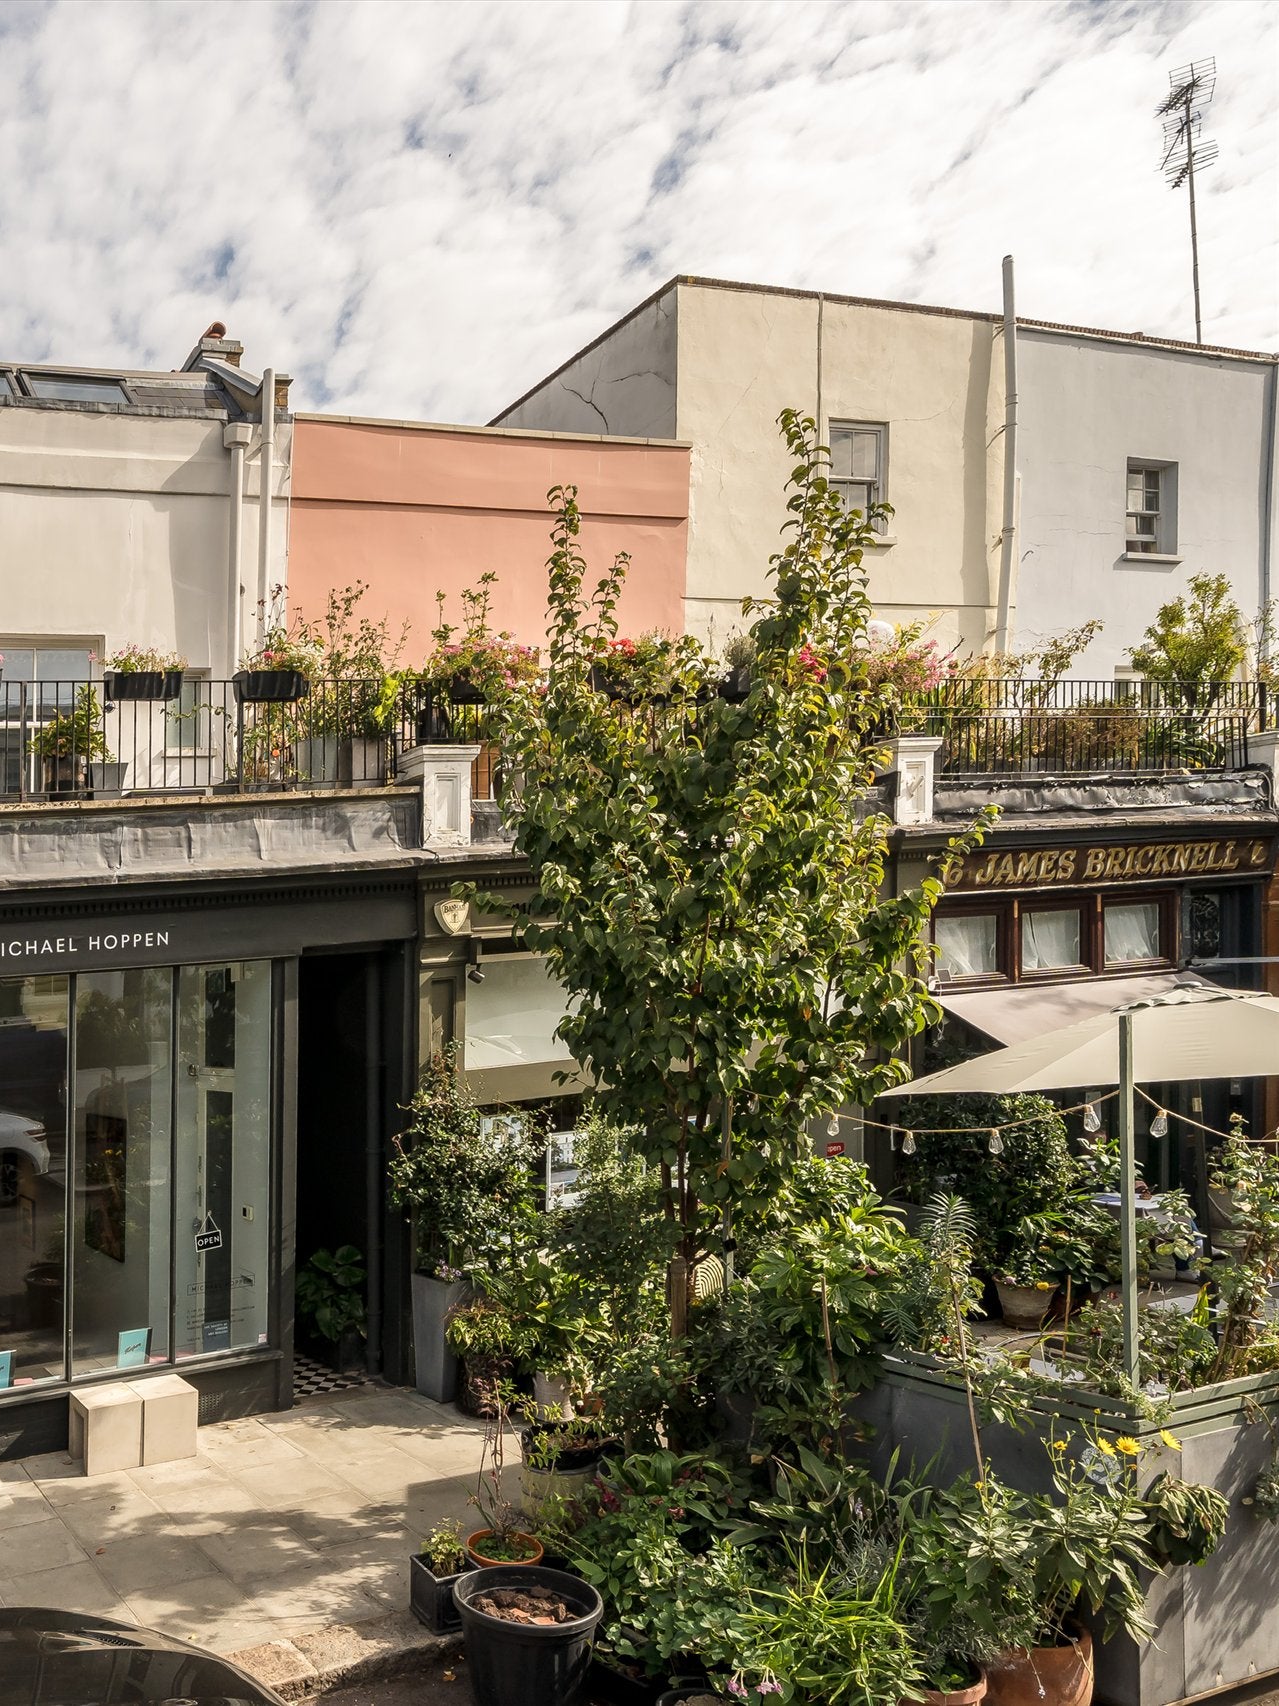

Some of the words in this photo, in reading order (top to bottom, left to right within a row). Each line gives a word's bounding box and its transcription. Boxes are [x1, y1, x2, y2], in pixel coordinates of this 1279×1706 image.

[975, 849, 1077, 887] JAMES
[1083, 841, 1239, 879] BRICKNELL
[89, 932, 169, 951] HOPPEN
[197, 1236, 220, 1247] OPEN
